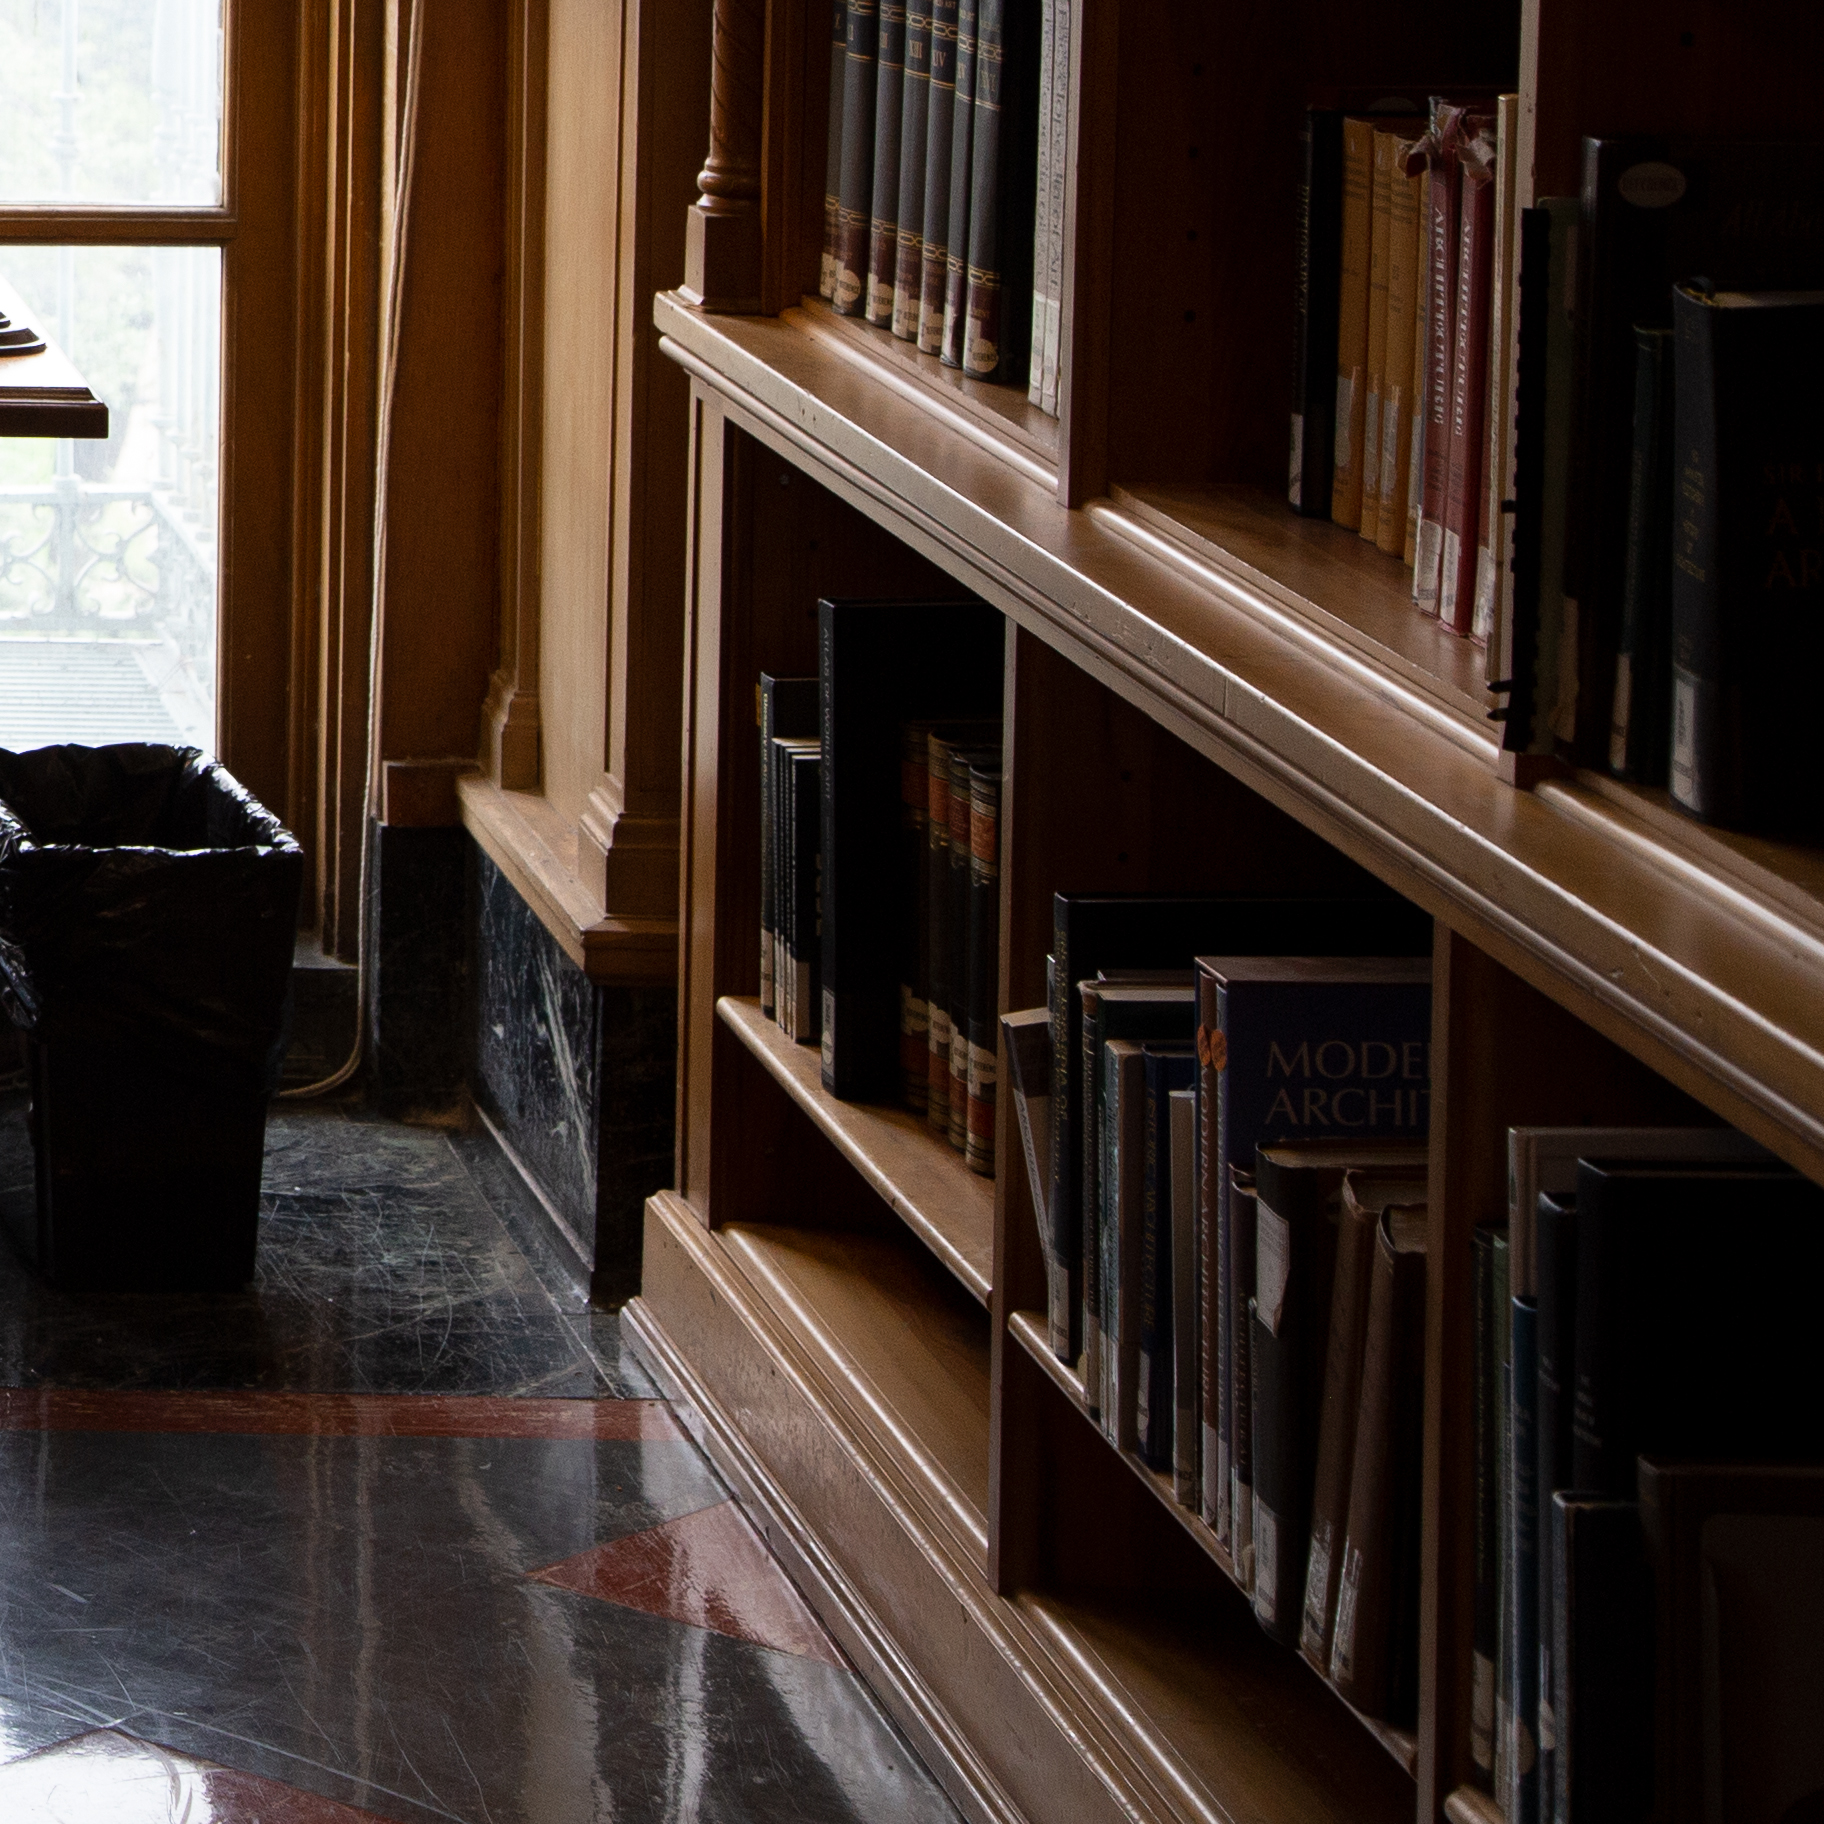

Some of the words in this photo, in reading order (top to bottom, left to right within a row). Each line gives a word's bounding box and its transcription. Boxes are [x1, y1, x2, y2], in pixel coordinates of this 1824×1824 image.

[1299, 184, 1309, 293] DICTIONARY
[1433, 206, 1445, 424] ARCHITECTURE
[1454, 216, 1472, 435] ARCHITECTURE
[1762, 462, 1805, 486] SIR
[1763, 496, 1800, 537] A
[822, 627, 831, 676] ATLAS
[822, 681, 831, 701] OF
[822, 706, 832, 765] WORLD
[823, 770, 831, 800] ART
[1265, 1039, 1430, 1080] MODE
[1145, 1087, 1157, 1176] HISTORIC
[1199, 1064, 1210, 1190] MODERN
[1143, 1181, 1155, 1330] ARCHITECTURE
[1199, 1198, 1212, 1402] ARCHITECTURE
